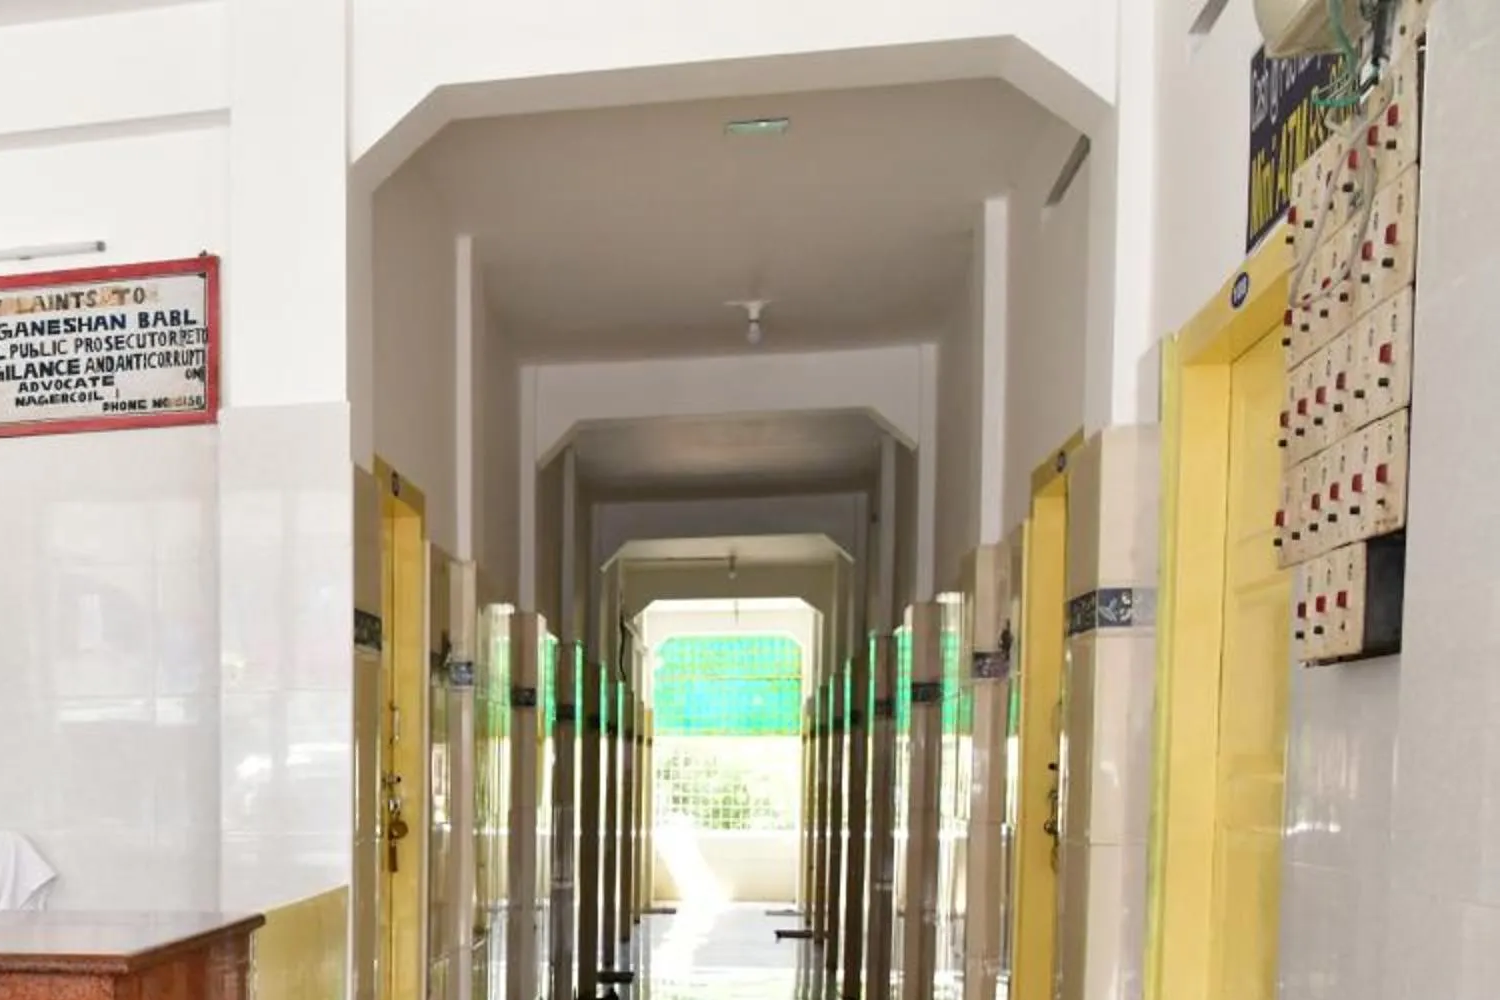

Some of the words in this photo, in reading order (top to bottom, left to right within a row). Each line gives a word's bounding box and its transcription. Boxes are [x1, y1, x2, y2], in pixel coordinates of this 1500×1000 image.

[111, 287, 146, 307] TO
[18, 375, 115, 394] ADVOCATE
[15, 391, 104, 407] NAGERCOIL
[102, 399, 148, 412] PHONE
